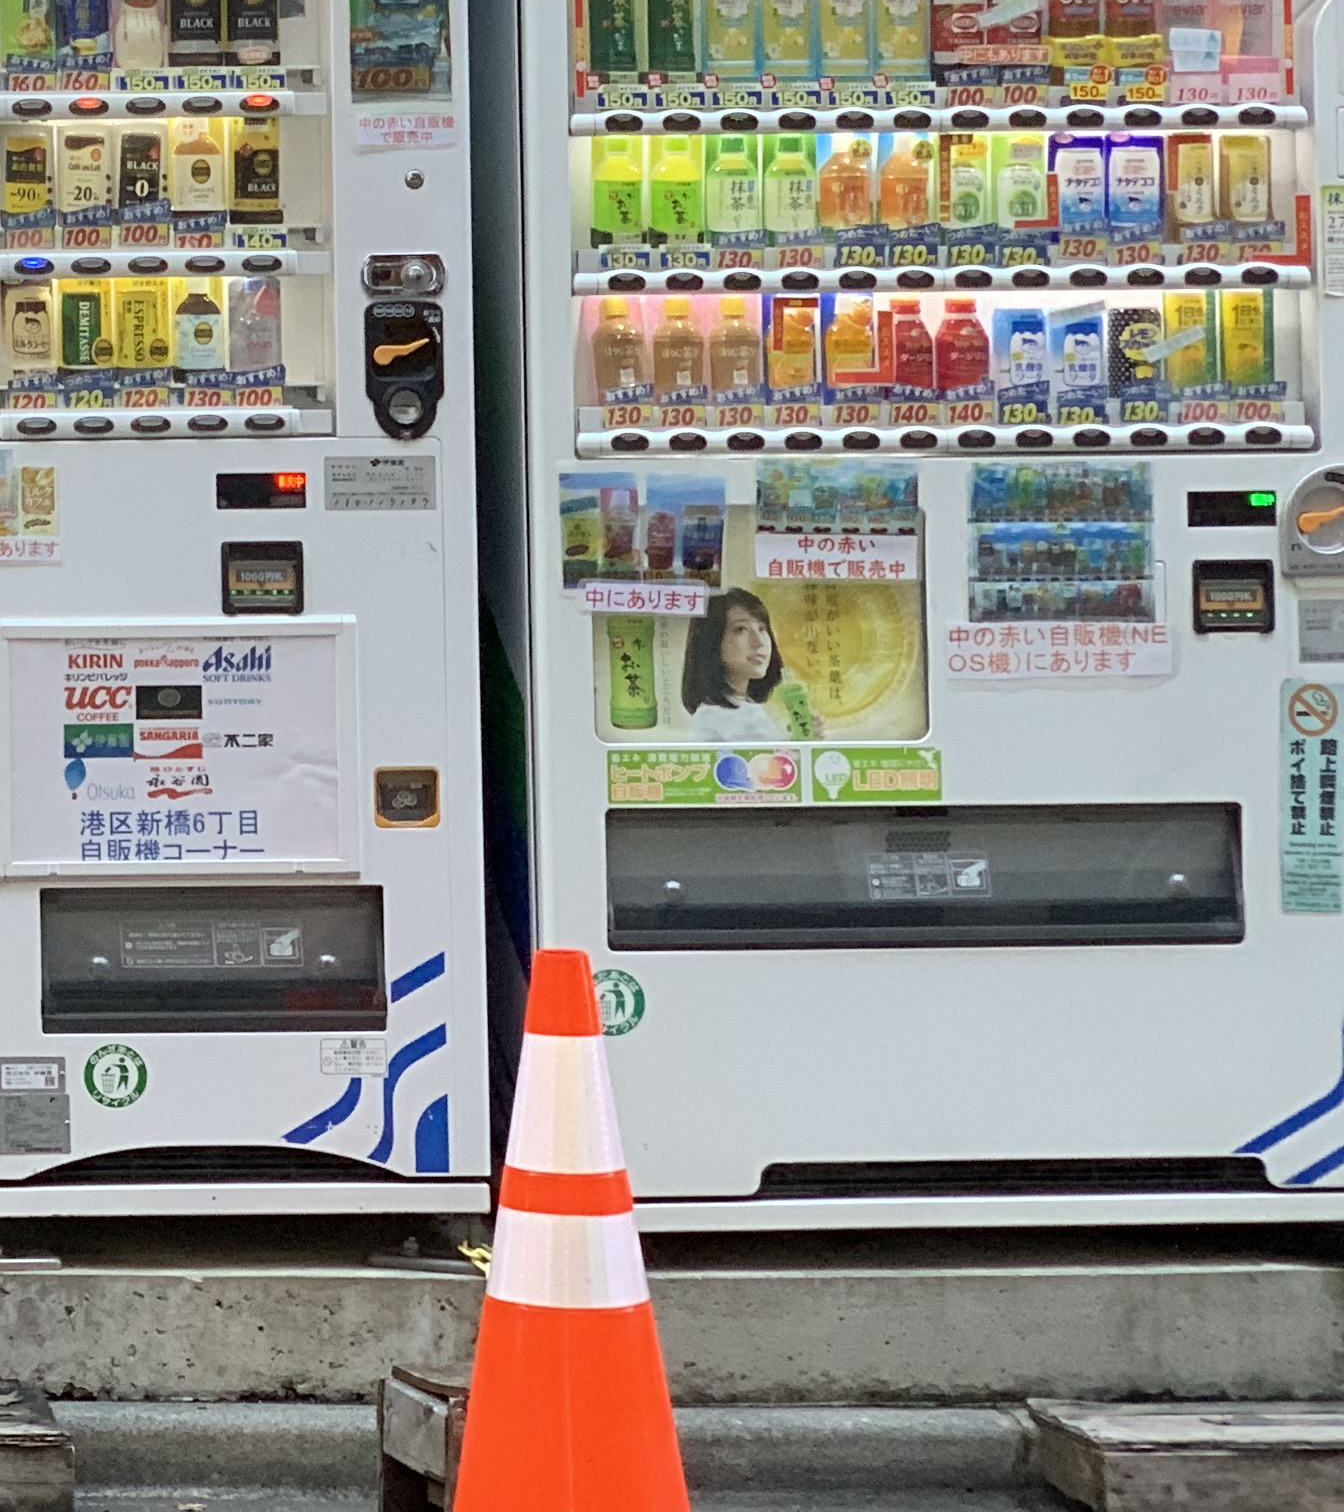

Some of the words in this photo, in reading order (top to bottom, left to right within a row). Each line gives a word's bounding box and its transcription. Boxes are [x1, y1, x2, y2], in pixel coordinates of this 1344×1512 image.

[797, 535, 877, 552] 中の赤い
[767, 559, 907, 580] 自販機で販売中
[585, 586, 704, 610] 中にあります
[67, 653, 124, 670] KIRIN
[201, 644, 273, 673] Asahi
[202, 674, 229, 683] SOFT
[231, 674, 272, 683] DRINKS
[76, 712, 120, 722] COFFEE
[139, 729, 200, 742] SANGARIA
[852, 769, 939, 791] LED照明
[86, 782, 136, 801] Otsuka
[80, 808, 260, 837] 港区新橋6丁目
[80, 838, 266, 862] 自販機コーナー
